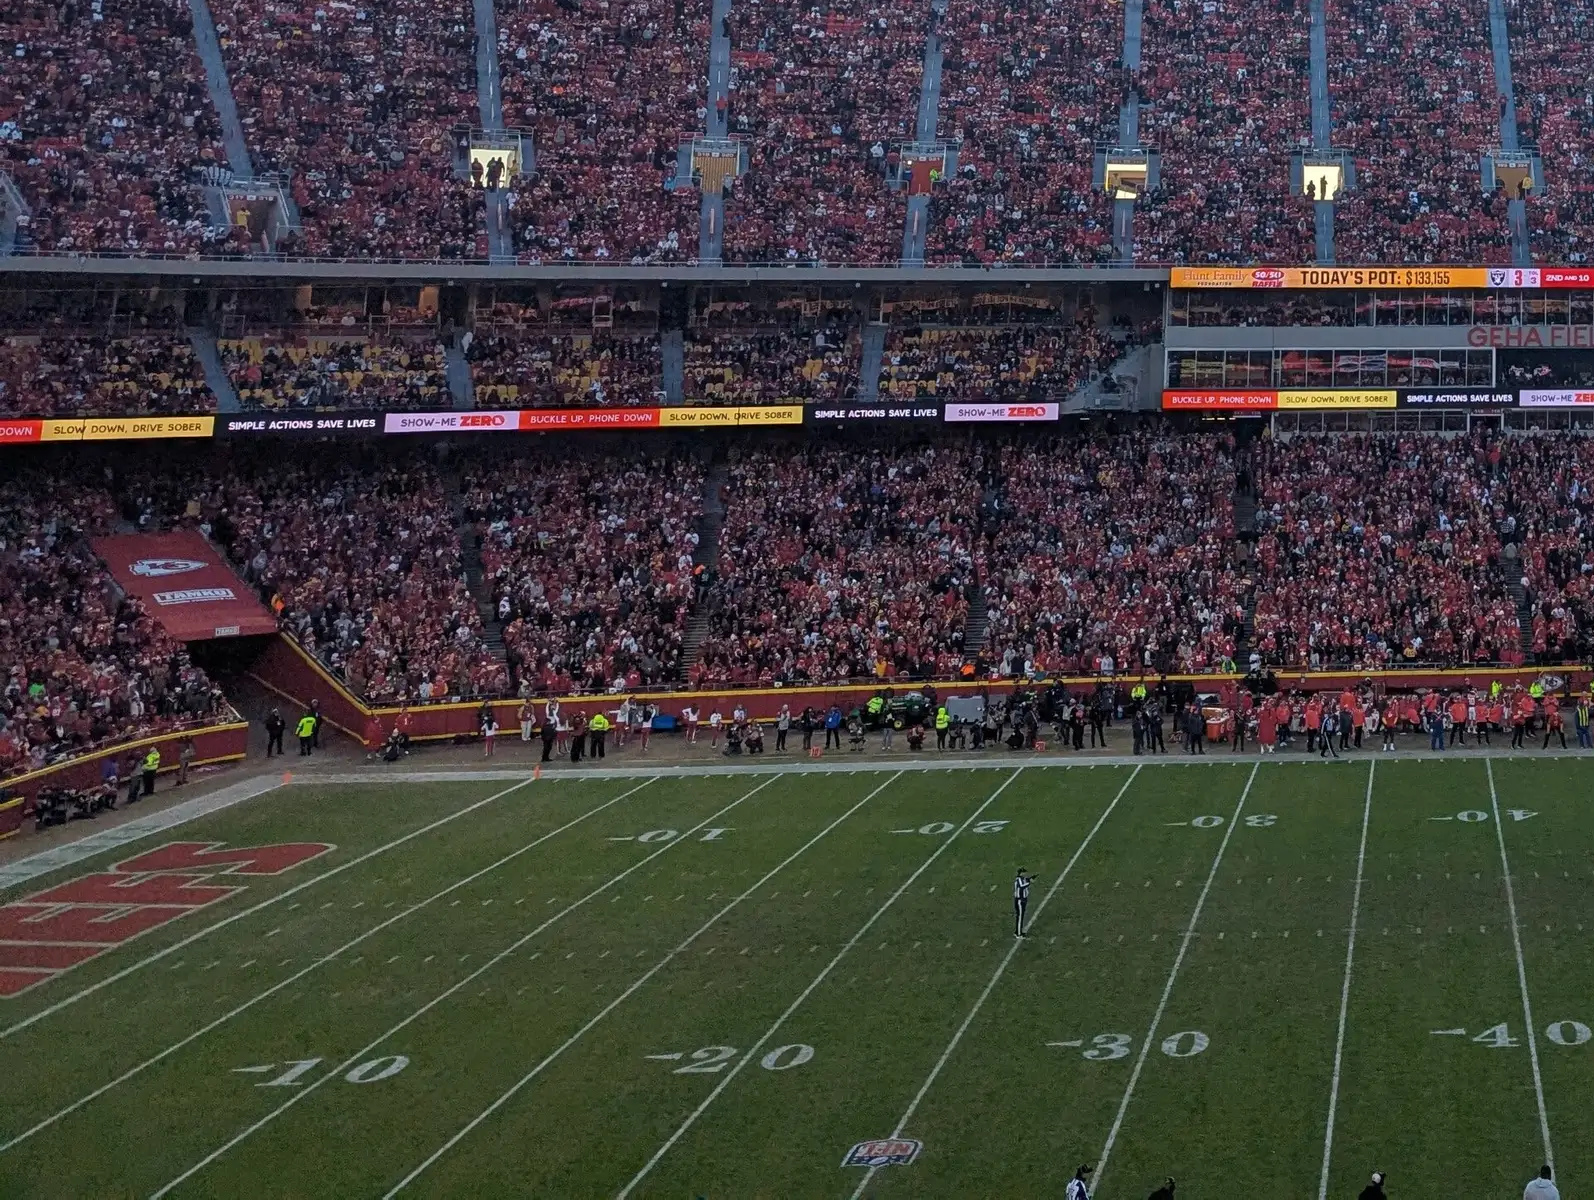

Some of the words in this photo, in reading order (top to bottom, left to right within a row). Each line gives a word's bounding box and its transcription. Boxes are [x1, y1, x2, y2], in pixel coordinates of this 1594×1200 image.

[1184, 271, 1209, 280] Hunt
[1214, 271, 1247, 283] Family
[1255, 271, 1281, 279] 50/50
[1301, 270, 1363, 285] TODAY'S
[1368, 270, 1401, 285] POT:
[1406, 270, 1450, 285] $133,155
[1514, 270, 1523, 286] 3
[1467, 326, 1543, 348] GEHA
[1311, 396, 1336, 404] DOWN,
[700, 413, 730, 421] DOWN,
[734, 412, 760, 420] DRIVE
[815, 410, 845, 418] SIMPLE
[889, 409, 910, 417] SAVE
[958, 408, 1005, 416] SHOW-ME
[1008, 407, 1045, 416] ZERO
[228, 421, 265, 430] SIMPLE
[269, 420, 313, 429] ACTIONS
[317, 420, 343, 428] SAVE
[347, 419, 375, 428] LIVES
[400, 418, 456, 427] SHOW-ME
[460, 415, 505, 426] ZERO
[530, 415, 567, 424] BUCKLE
[571, 415, 586, 423] UP,
[589, 414, 619, 422] PHONE
[624, 414, 652, 422] DOWN
[0, 427, 32, 436] DOWN
[54, 426, 86, 434] SLOW
[91, 425, 128, 434] DOWN,
[133, 424, 163, 432] DRIVE
[168, 423, 201, 431] SOBER
[1472, 1020, 1593, 1048] 40
[1081, 1031, 1209, 1060] 30
[674, 1045, 814, 1073] 20
[255, 1056, 410, 1086] 10
